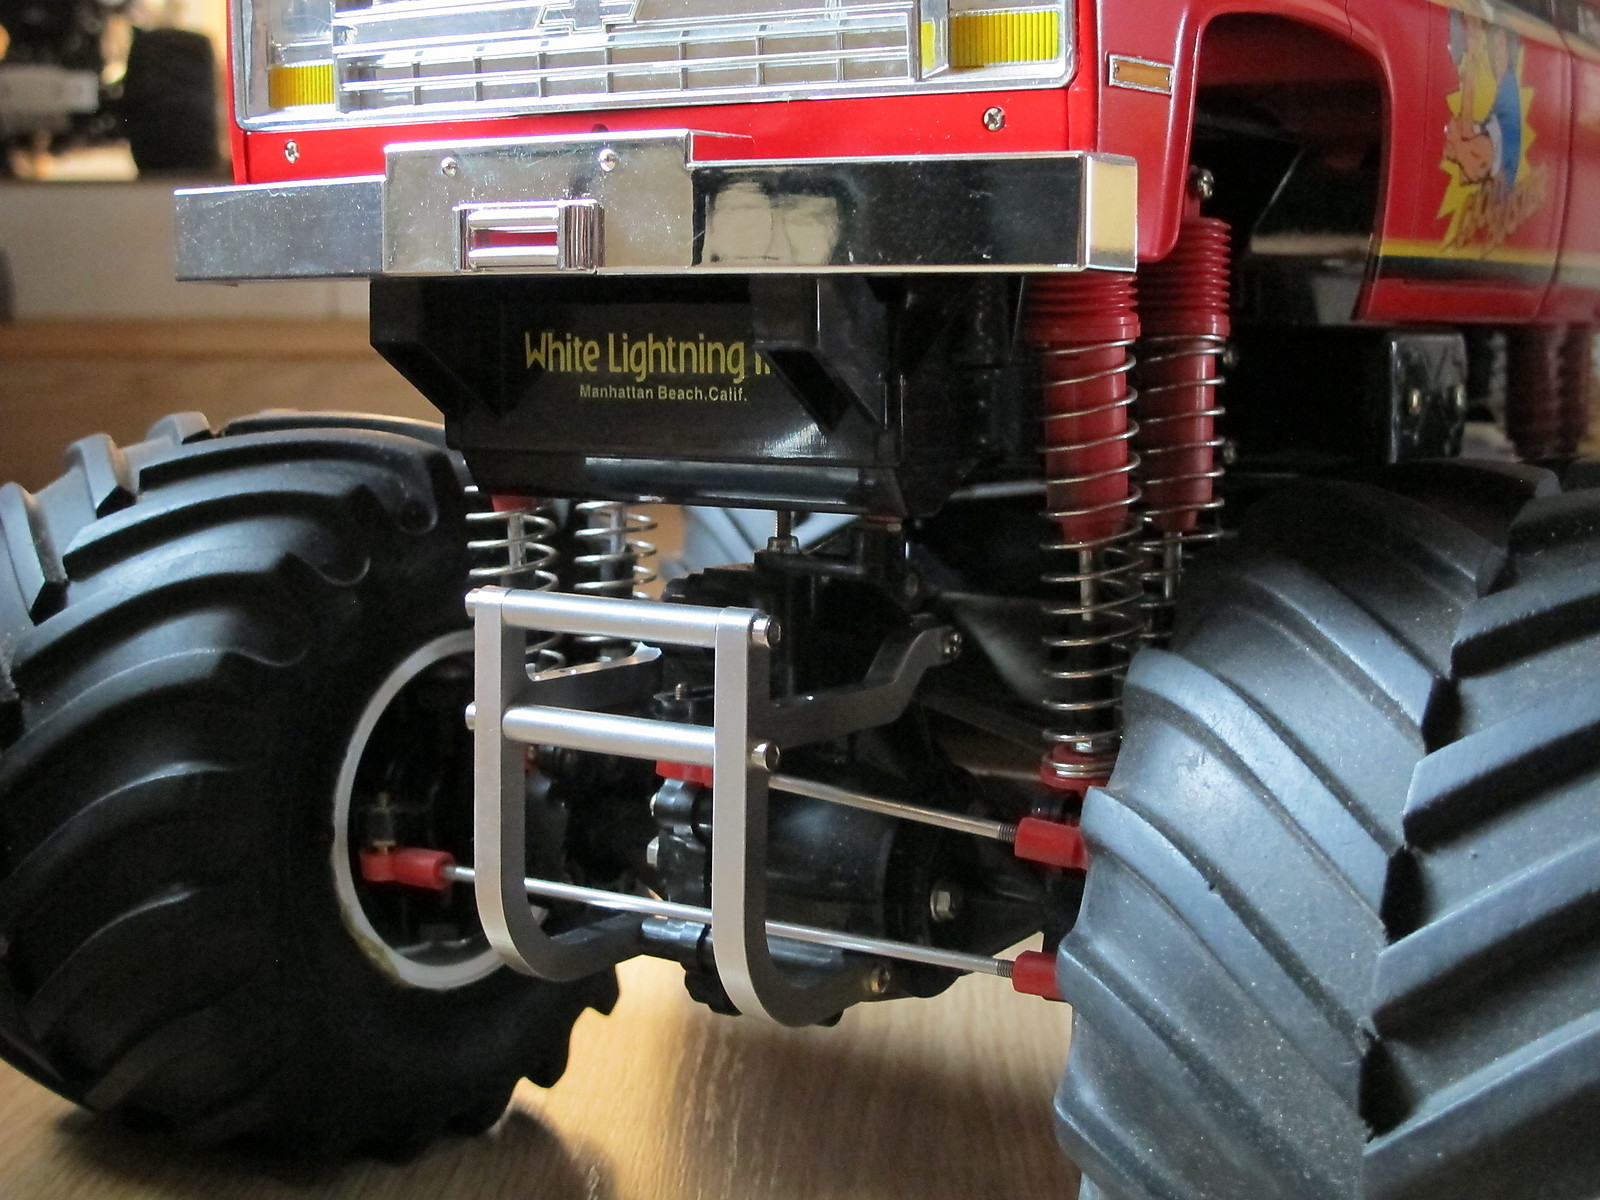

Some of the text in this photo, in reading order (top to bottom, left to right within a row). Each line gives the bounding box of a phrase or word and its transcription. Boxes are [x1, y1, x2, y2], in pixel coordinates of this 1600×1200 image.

[525, 332, 600, 372] White
[608, 332, 745, 384] Lightning
[579, 384, 653, 399] Manhattan
